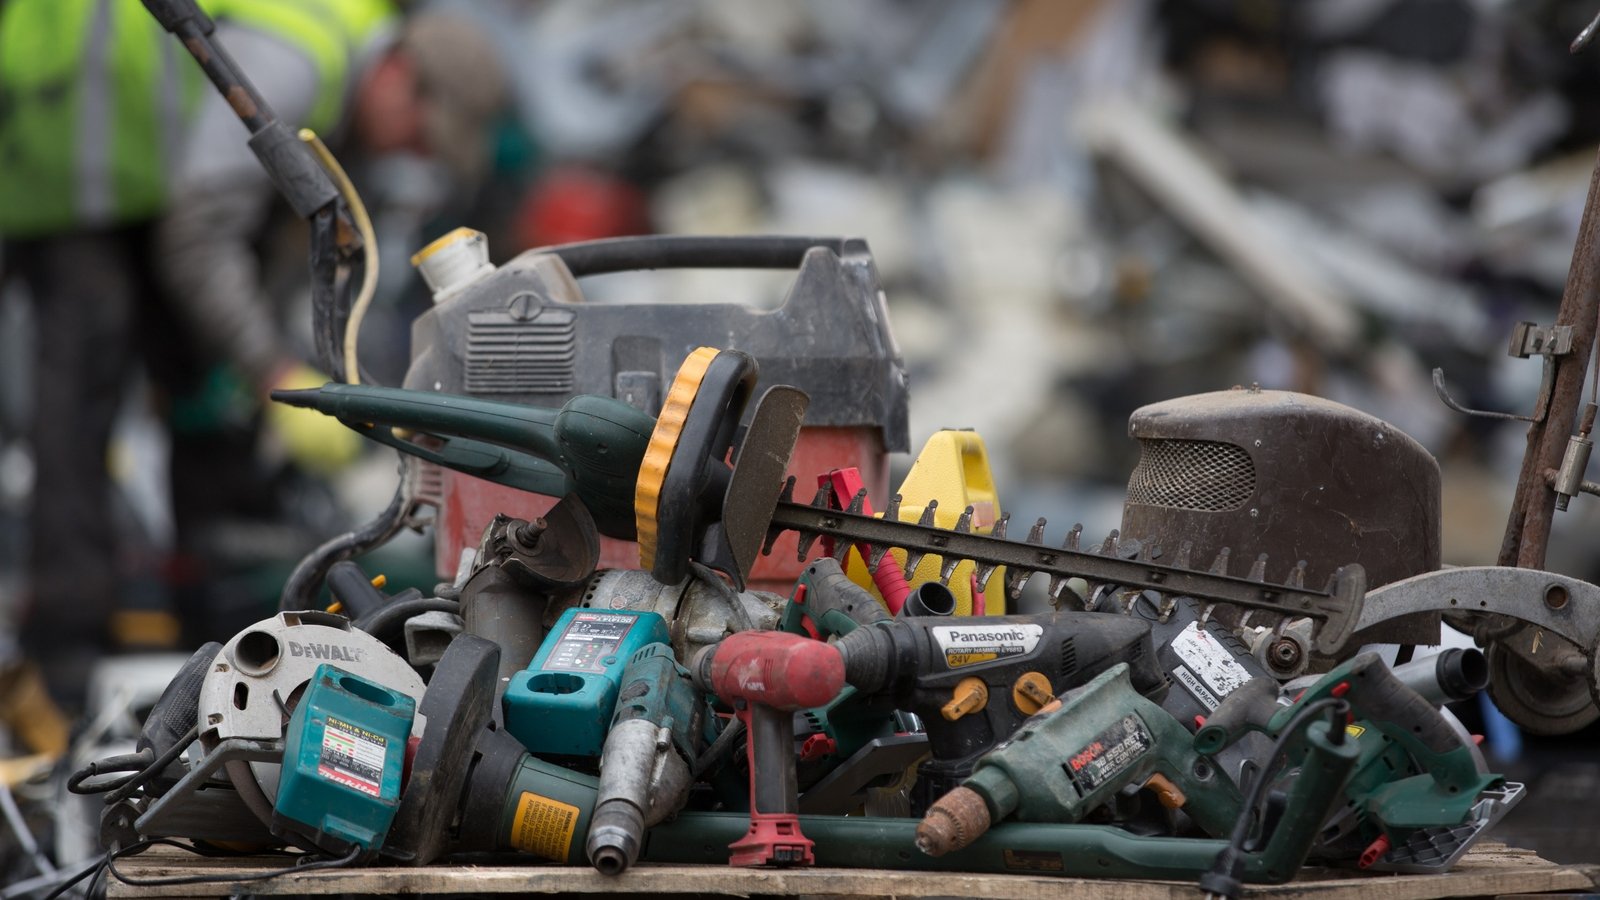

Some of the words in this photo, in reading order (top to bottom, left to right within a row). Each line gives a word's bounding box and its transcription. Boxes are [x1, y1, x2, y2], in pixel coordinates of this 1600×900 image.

[950, 629, 1025, 643] Panasonic
[947, 647, 973, 655] ROTARY
[973, 646, 1000, 654] HAMMER
[951, 655, 971, 664] 24V
[1181, 671, 1196, 687] HIGH
[1194, 685, 1218, 708] CAPACITY
[1071, 741, 1105, 772] BOSCH
[1106, 743, 1125, 760] 550
[1115, 742, 1144, 763] CONTROL
